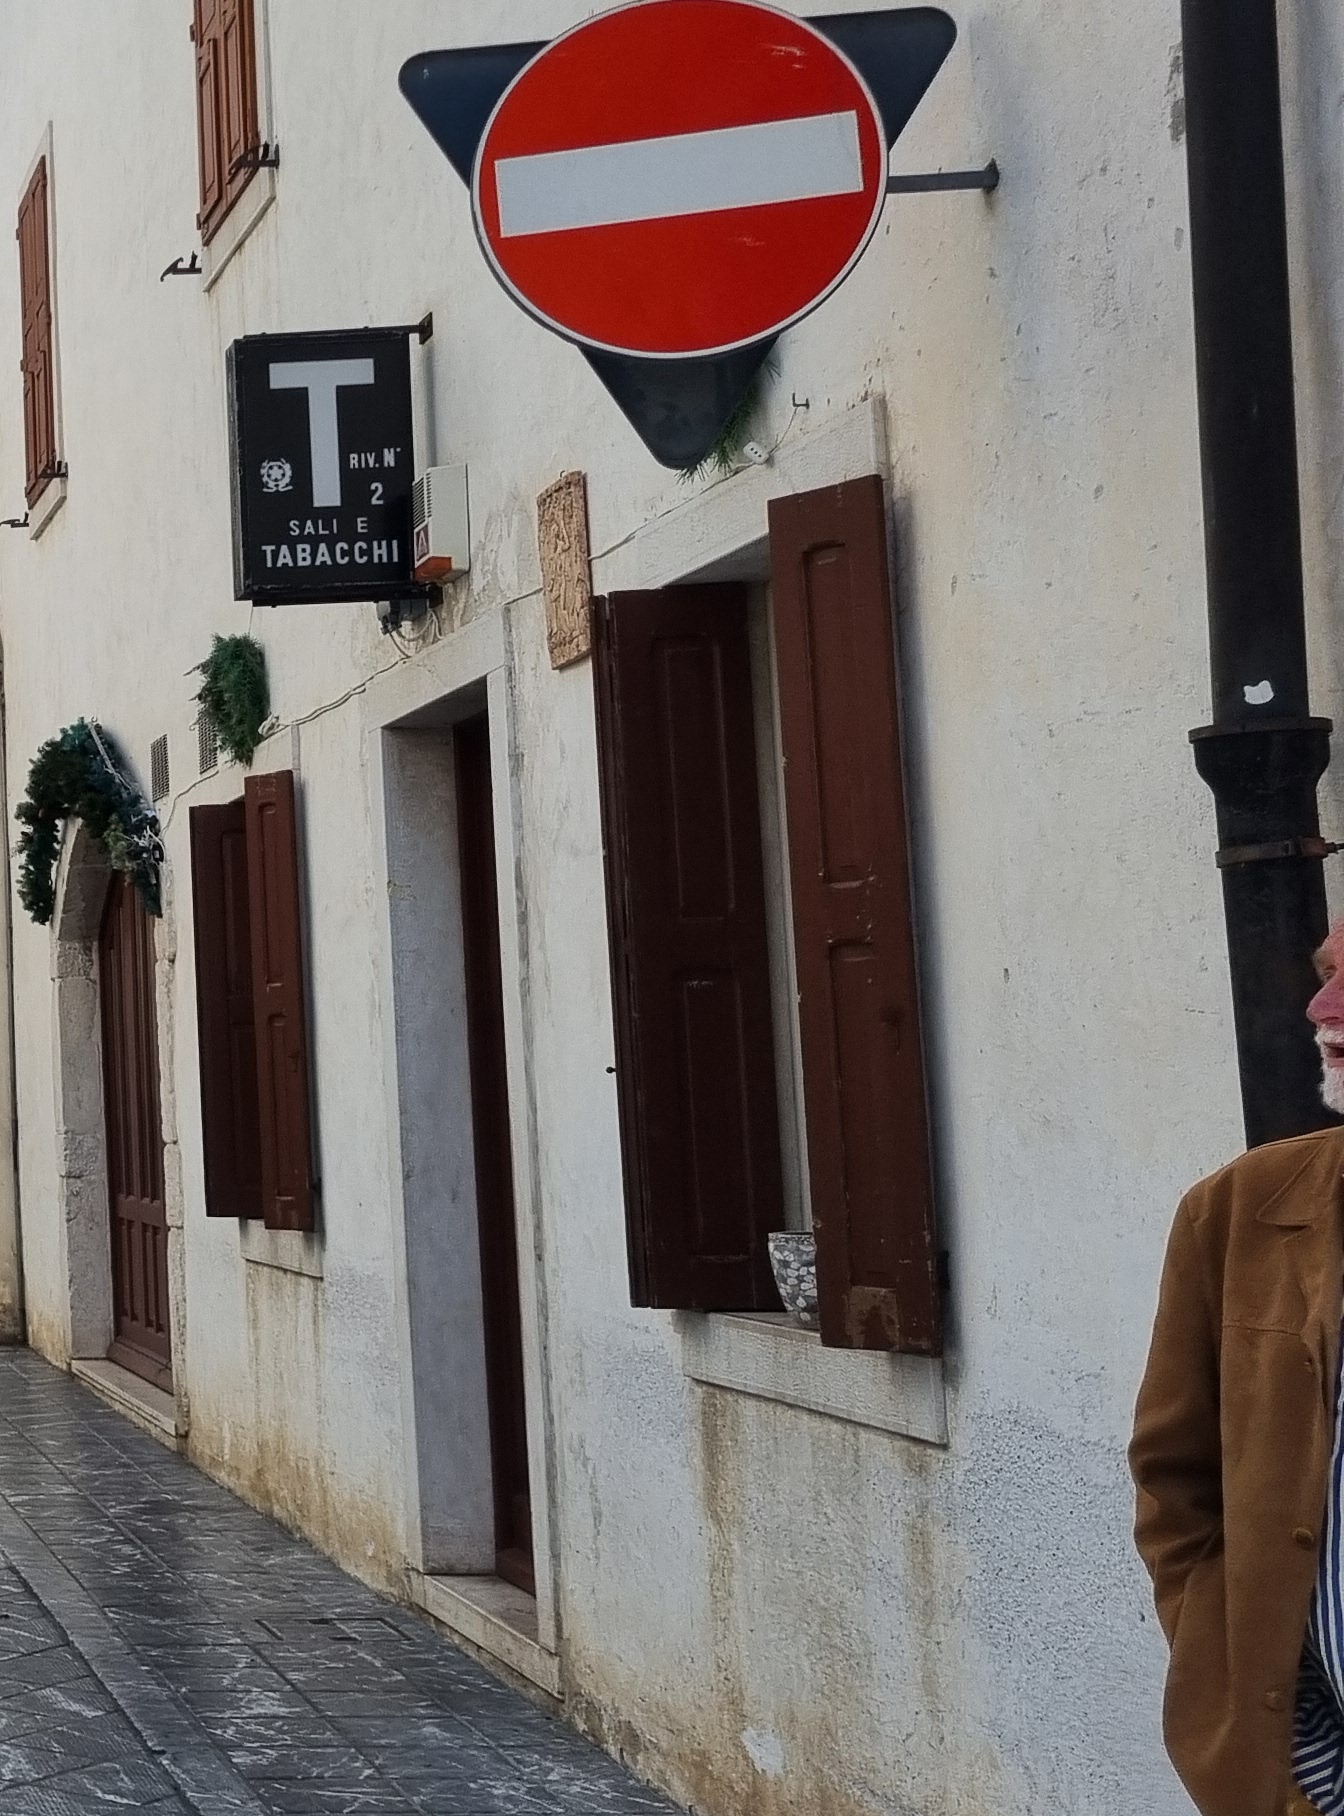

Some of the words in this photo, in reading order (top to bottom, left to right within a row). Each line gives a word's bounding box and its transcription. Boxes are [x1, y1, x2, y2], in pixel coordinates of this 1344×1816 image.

[269, 358, 375, 508] T
[349, 452, 380, 469] RIV.
[370, 481, 384, 505] 2
[289, 518, 338, 536] SALI
[357, 517, 368, 533] E
[262, 539, 399, 568] TABACCHI
